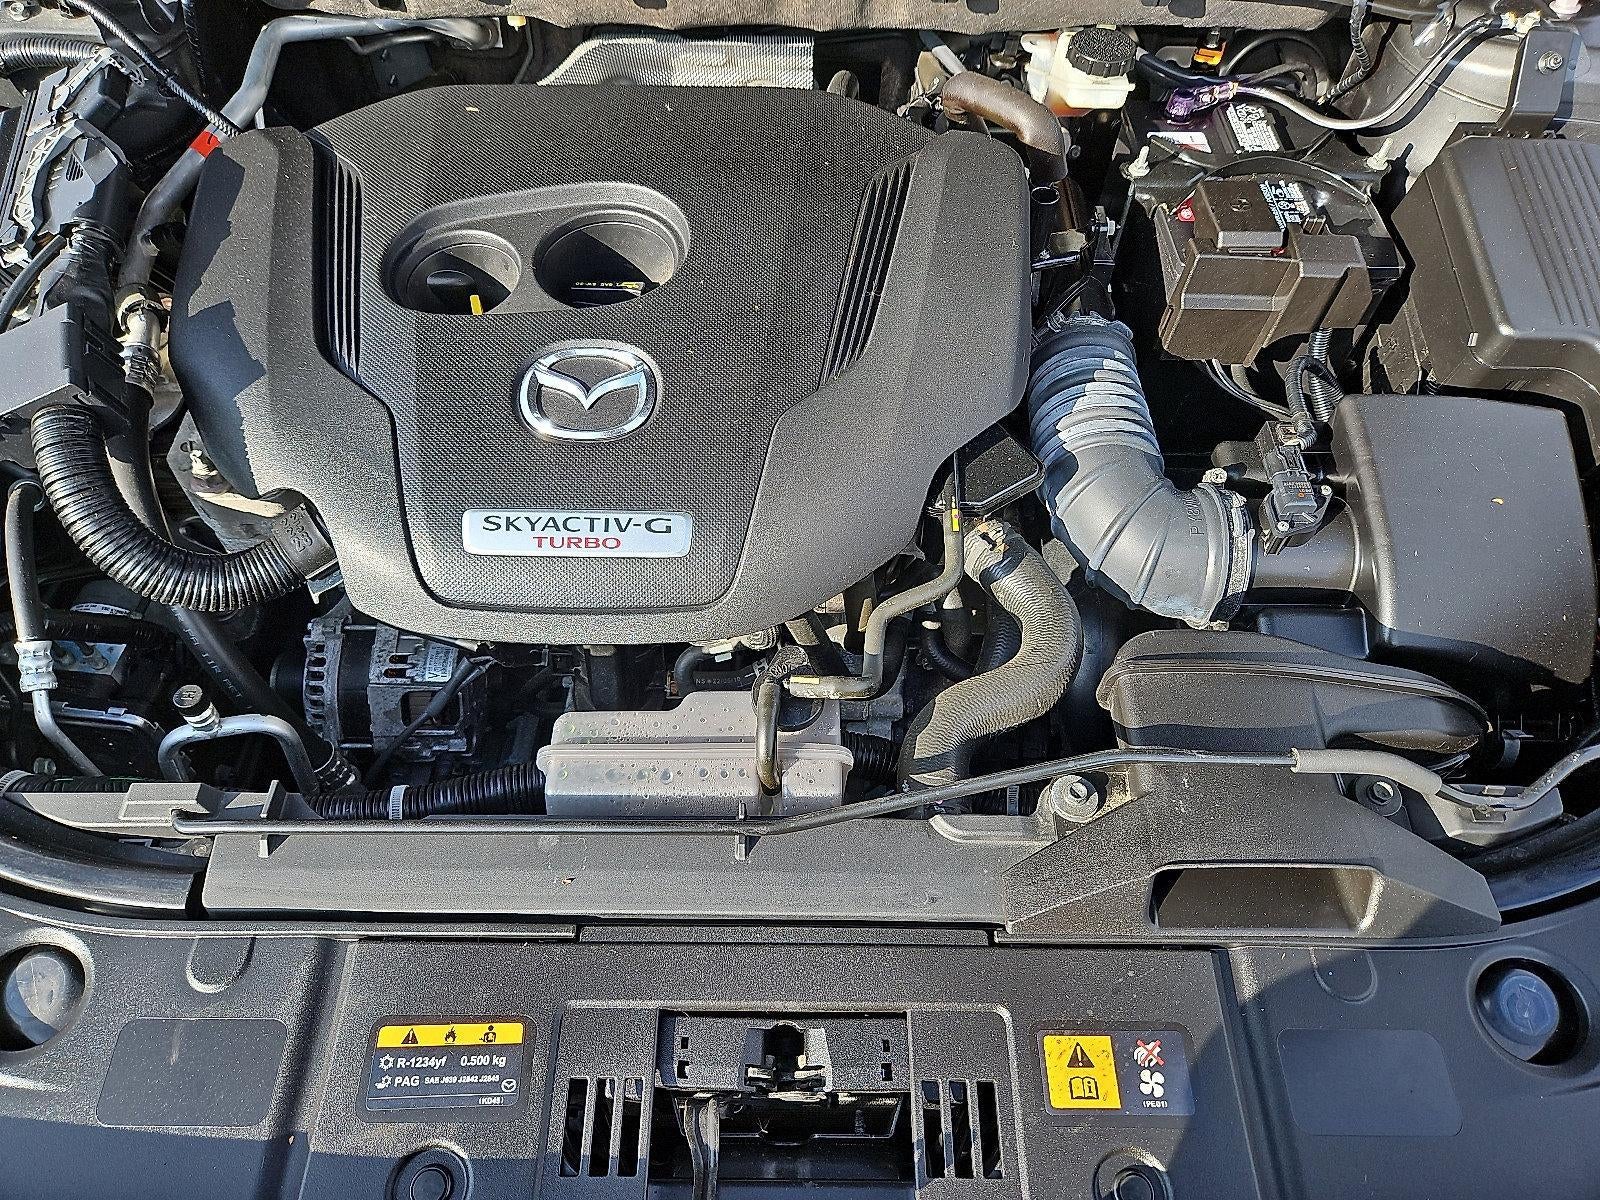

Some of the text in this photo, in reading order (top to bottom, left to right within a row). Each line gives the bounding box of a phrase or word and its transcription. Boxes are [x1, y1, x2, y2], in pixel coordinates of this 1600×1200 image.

[482, 515, 672, 533] SKYACTIV-G
[532, 536, 621, 549] TURBO
[396, 1054, 507, 1069] R-1234yf 0.500 kg
[393, 1075, 420, 1087] PAG
